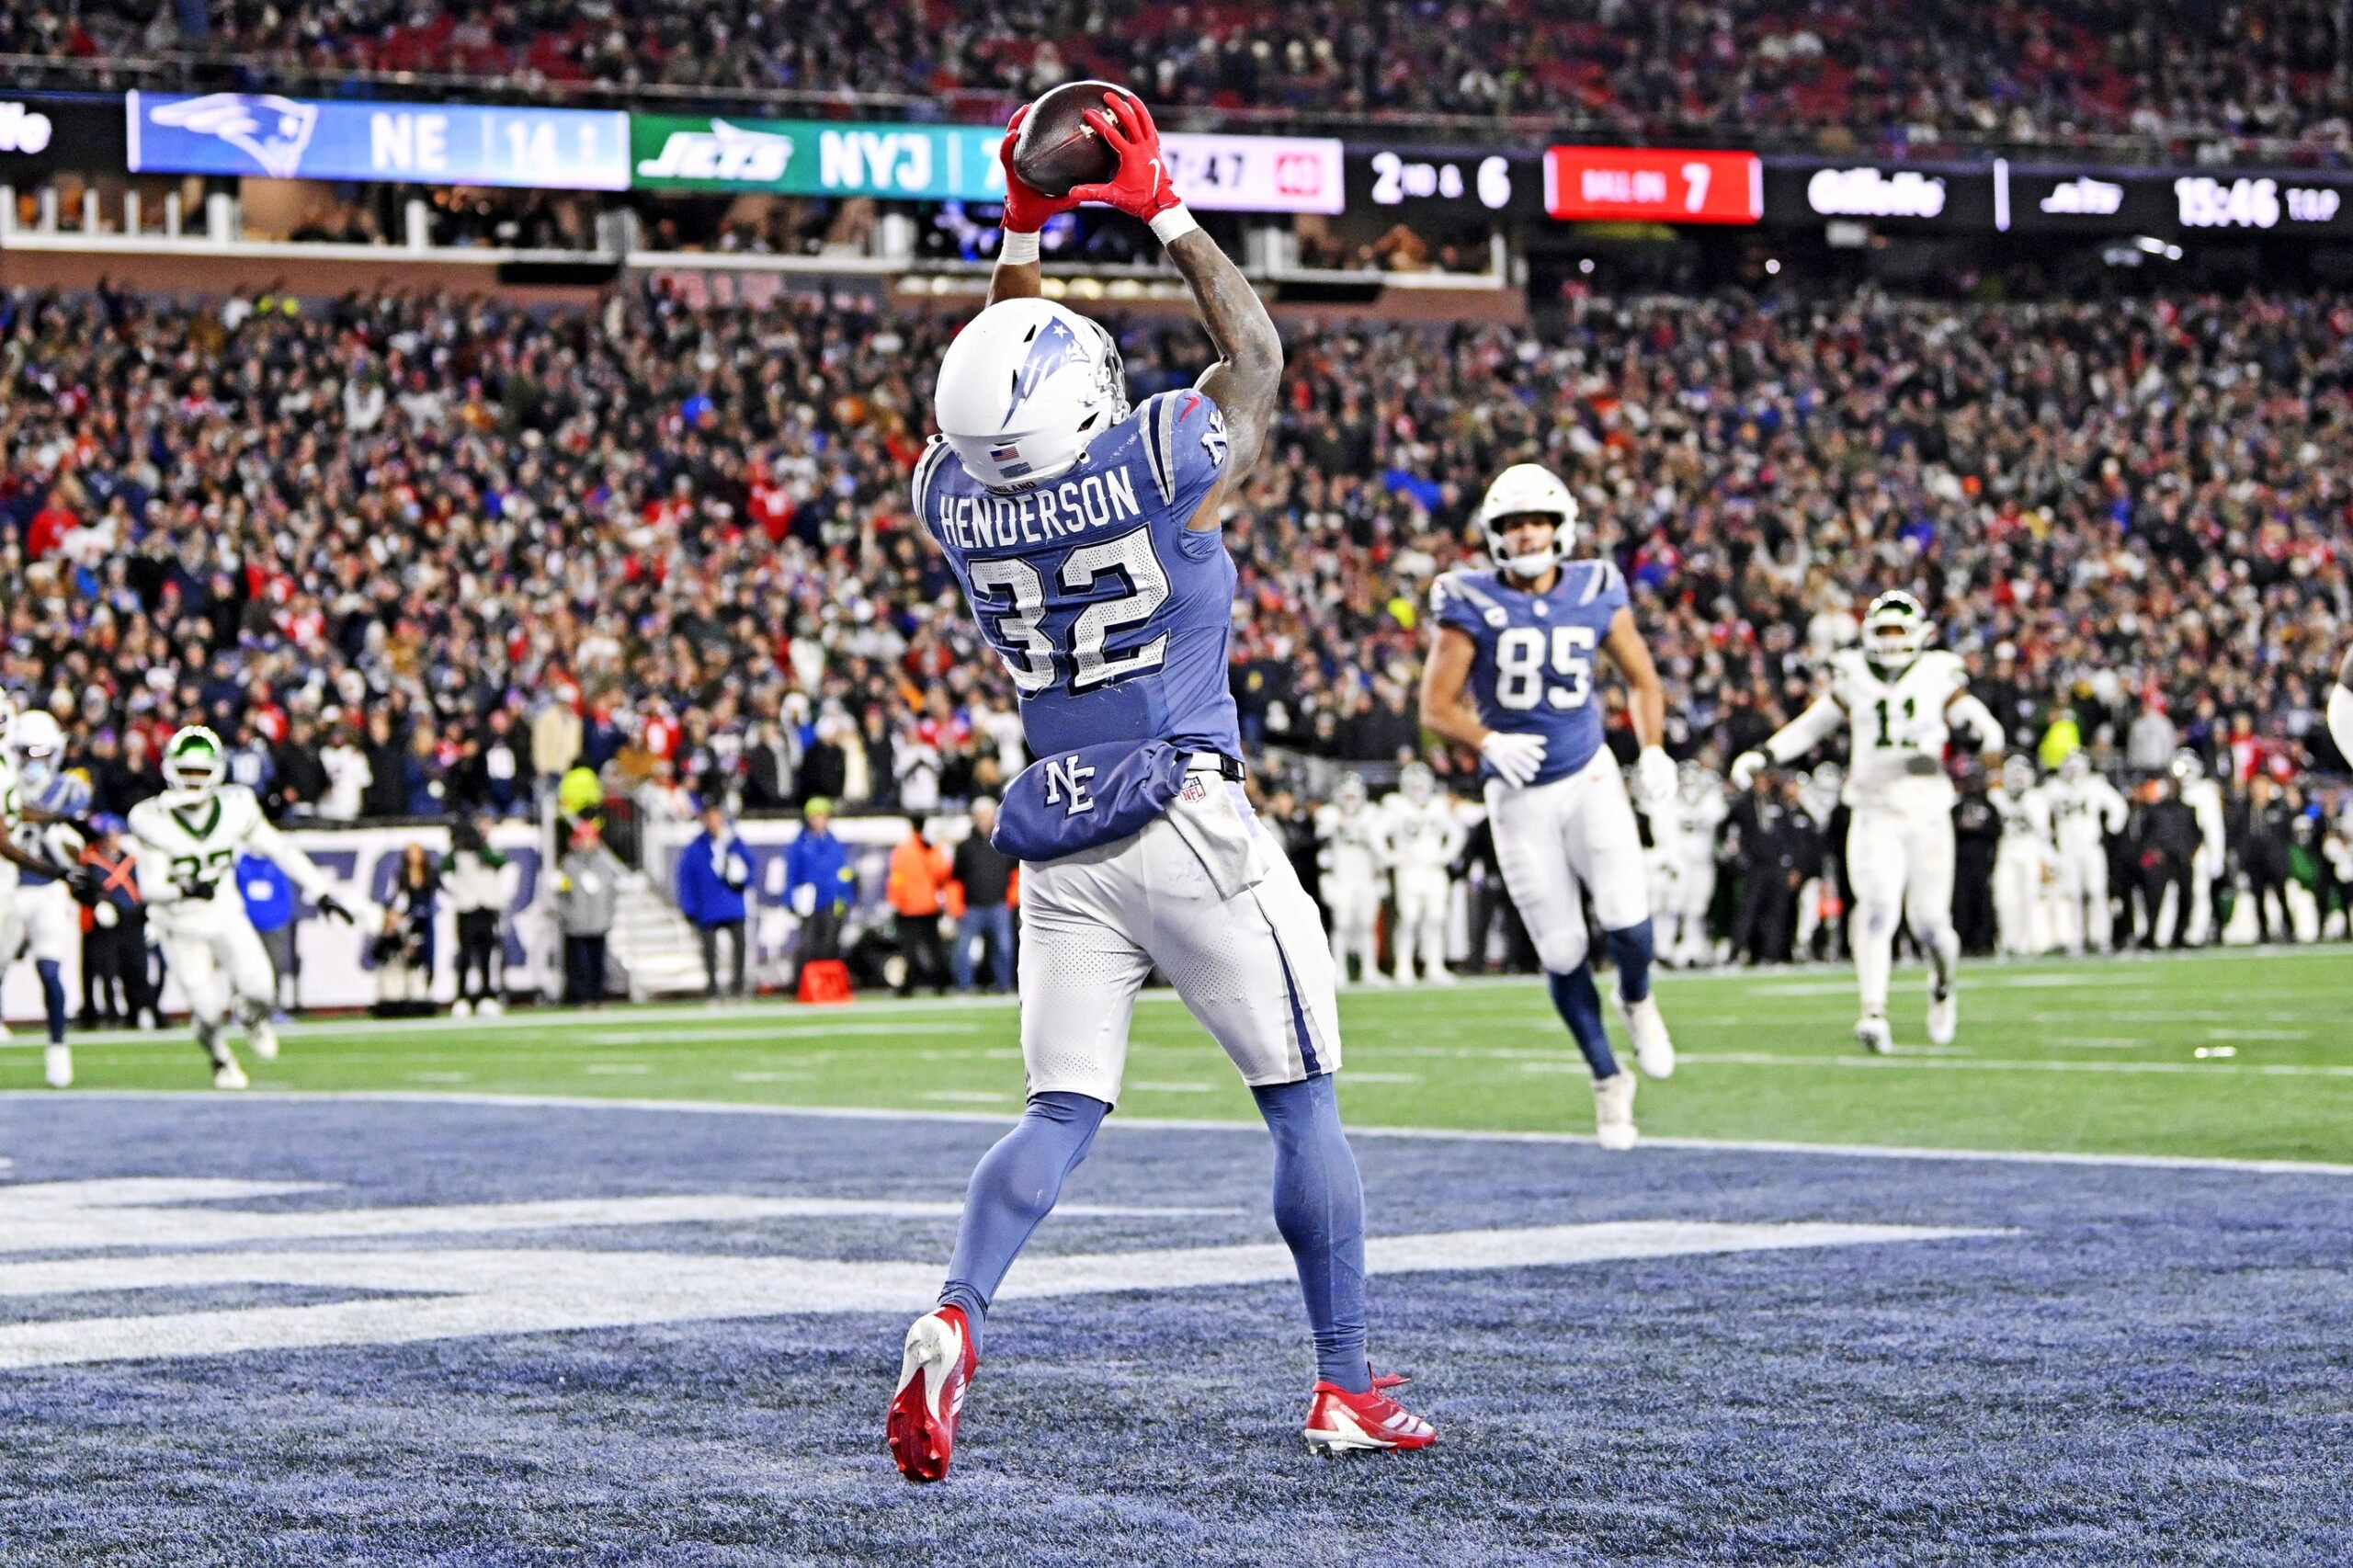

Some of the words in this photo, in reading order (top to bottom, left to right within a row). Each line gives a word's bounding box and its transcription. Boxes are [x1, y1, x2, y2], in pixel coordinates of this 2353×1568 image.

[370, 112, 448, 171] NE
[506, 120, 556, 172] 14
[638, 118, 793, 181] JETS
[820, 131, 932, 189] NYJ
[1477, 155, 1511, 210] 6
[1681, 163, 1711, 213] 7
[939, 466, 1141, 549] HENDERSON
[967, 522, 1172, 701] 32
[1495, 627, 1596, 710] 85
[1875, 697, 1918, 747] 11
[1044, 754, 1095, 816] NE
[1182, 786, 1203, 801] NFL
